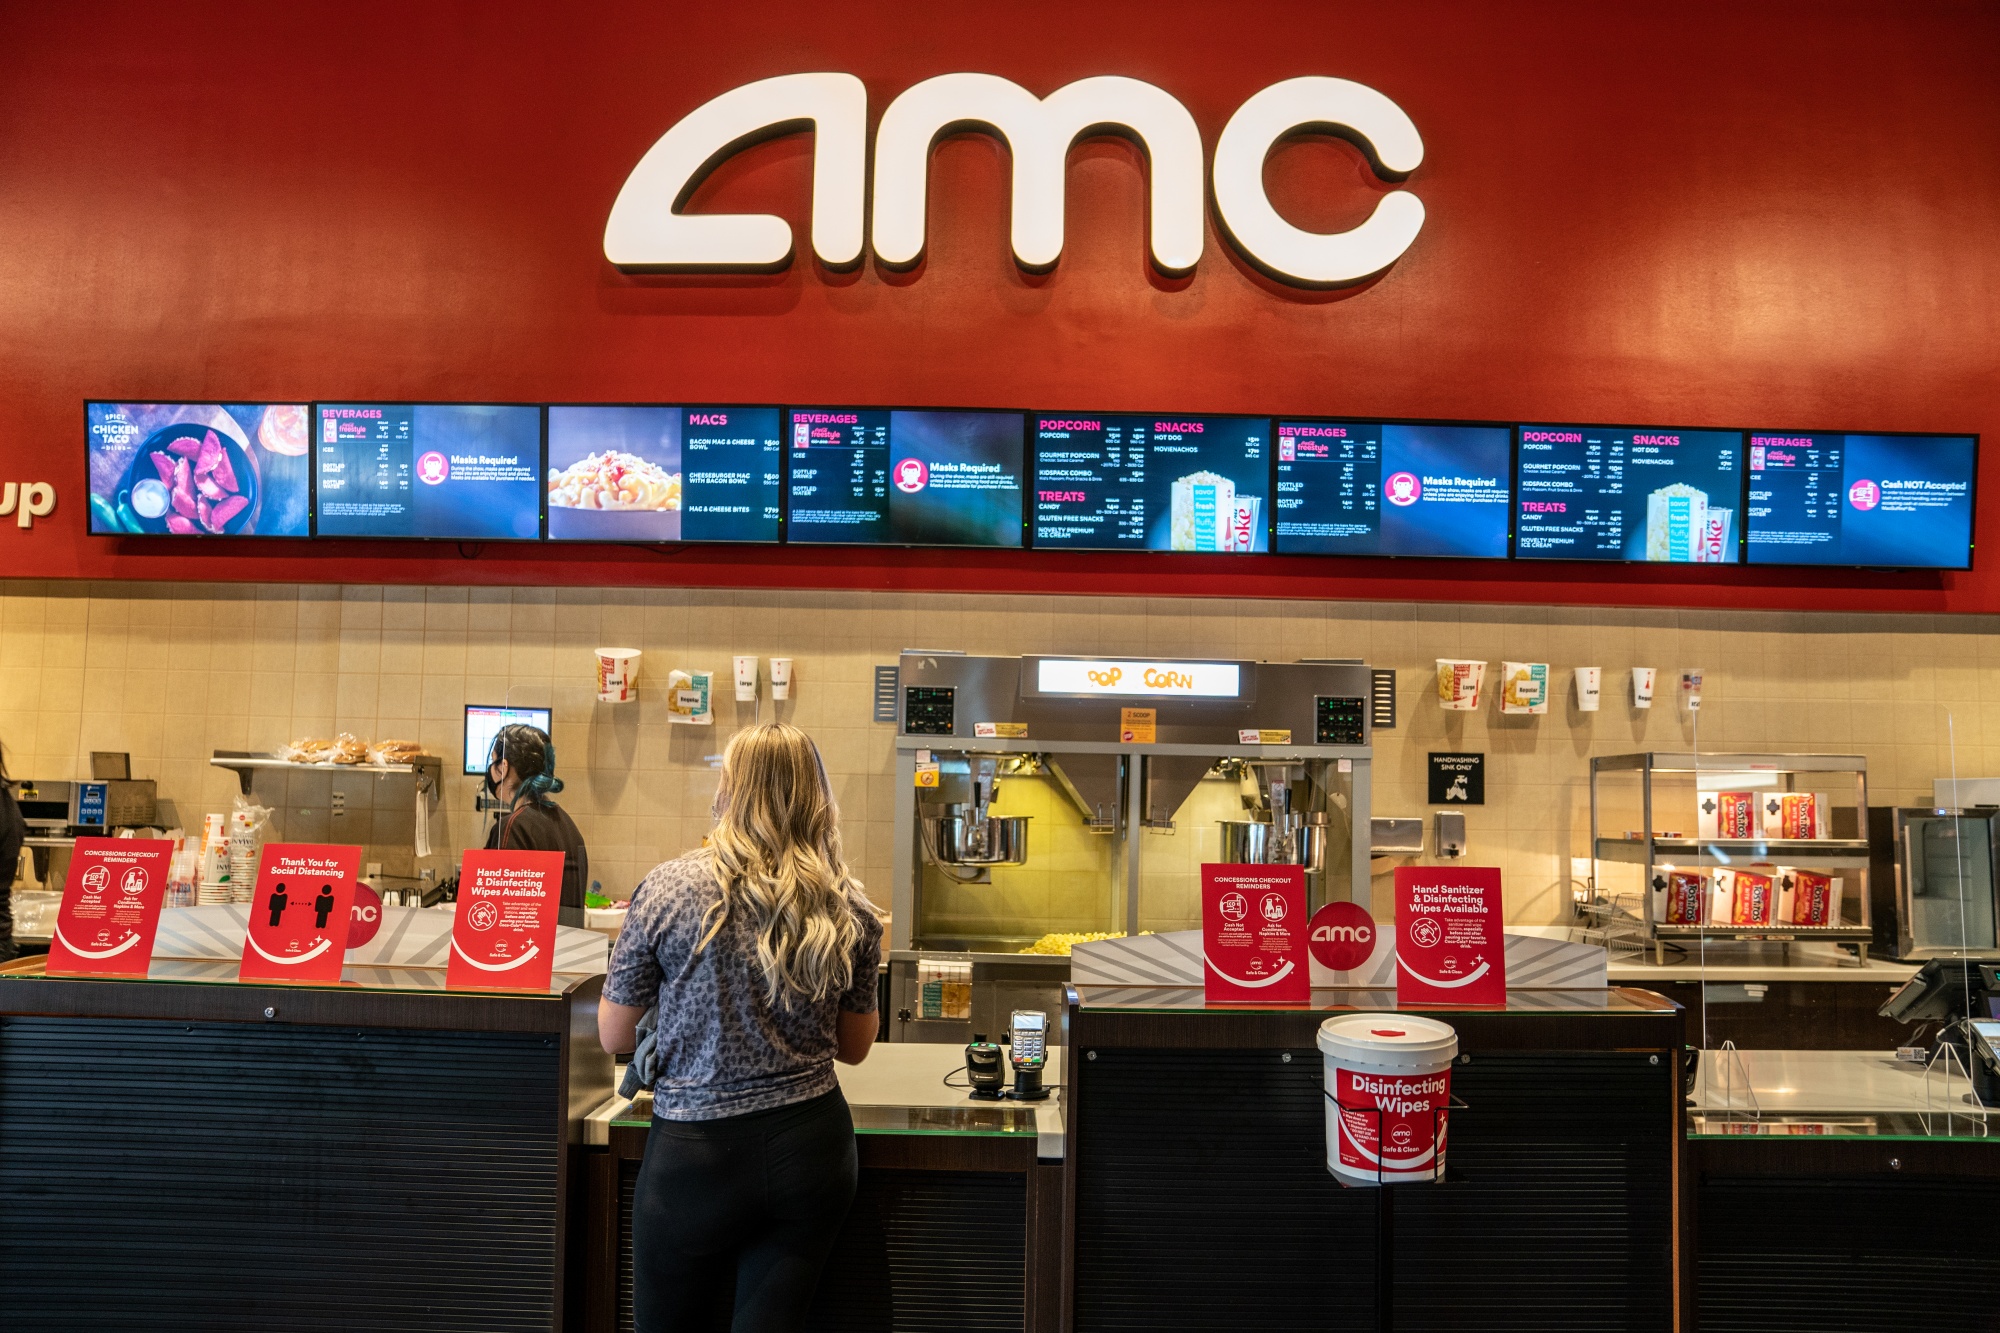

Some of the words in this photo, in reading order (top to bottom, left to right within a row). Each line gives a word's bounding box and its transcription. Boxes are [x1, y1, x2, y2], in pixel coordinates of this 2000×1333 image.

[323, 410, 382, 418] BEVERAGES
[794, 414, 857, 423] BEVERAGES
[690, 415, 727, 425] MACS
[1040, 420, 1100, 430] POPCORN
[93, 425, 138, 434] CHICKEN
[1154, 422, 1204, 433] SNACKS
[1279, 427, 1346, 437] BEVERAGES
[102, 435, 129, 443] TACO
[1524, 432, 1581, 442] POPCORN
[1633, 435, 1679, 445] SNACKS
[1751, 437, 1812, 447] BEVERAGES
[1298, 444, 1328, 453] freestyle
[451, 455, 477, 464] Masks
[480, 456, 517, 466] Required
[930, 463, 958, 472] Masks
[960, 463, 1000, 474] Required
[1423, 476, 1452, 485] Masks
[1455, 477, 1496, 488] Required
[1881, 480, 1903, 488] Cash
[1904, 481, 1924, 489] NOT
[1925, 481, 1966, 491] Accepted
[1039, 491, 1085, 501] TREATS
[1522, 502, 1566, 512] TREATS
[1144, 668, 1192, 689] CORN
[280, 858, 305, 866] Thank
[298, 868, 344, 878] Distancing
[477, 868, 501, 877] Hand
[504, 869, 545, 878] Sanitizer
[486, 878, 542, 889] Disinfecting
[471, 887, 500, 897] Wipes
[502, 888, 546, 897] Available
[1413, 885, 1438, 893] Hand
[1441, 886, 1484, 895] Sanitizer
[1423, 895, 1483, 906] Disinfecting
[1409, 904, 1441, 913] Wipes
[1444, 905, 1488, 913] Available
[1352, 1075, 1445, 1096] Disinfecting
[1375, 1096, 1430, 1117] Wipes
